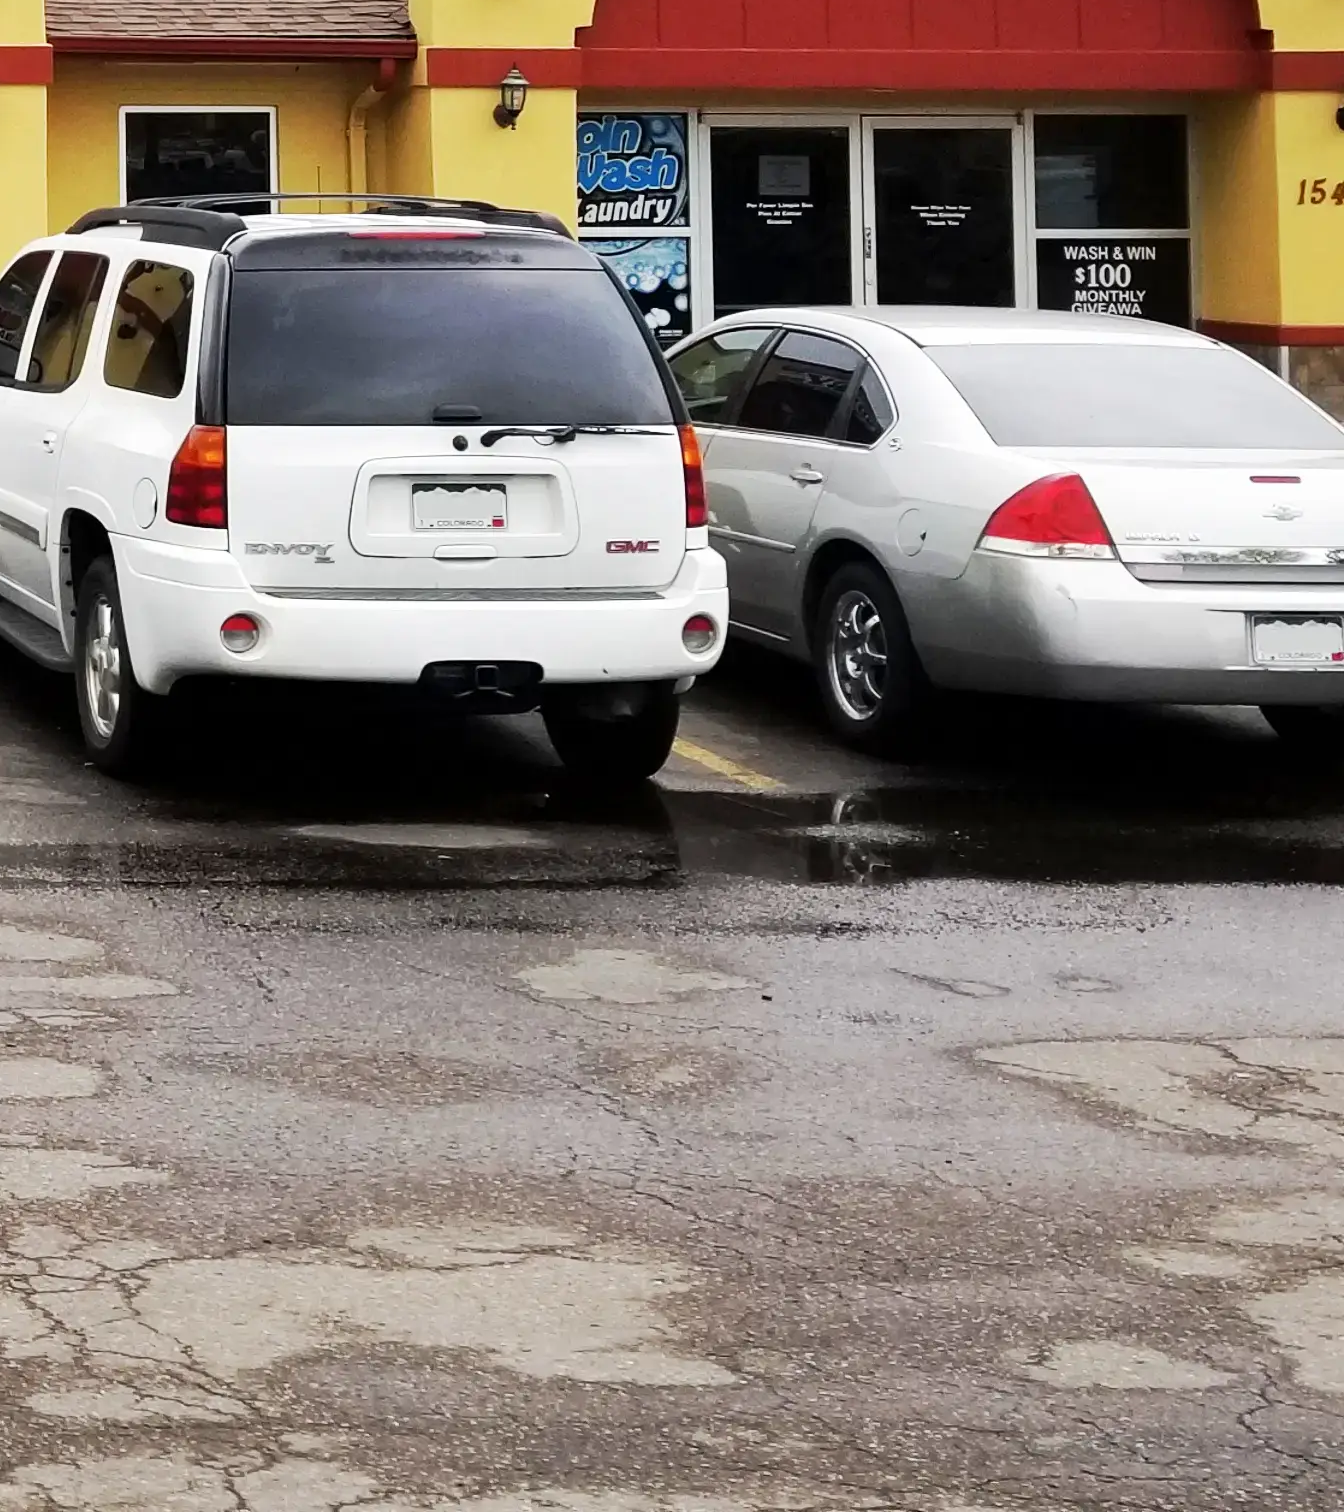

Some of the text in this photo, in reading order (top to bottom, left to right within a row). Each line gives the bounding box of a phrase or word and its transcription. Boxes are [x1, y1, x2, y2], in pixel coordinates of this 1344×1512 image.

[577, 114, 642, 154] oin
[1064, 246, 1156, 260] WASH & WIN
[1075, 263, 1132, 288] $100
[1075, 290, 1146, 303] MONTHLY
[1072, 302, 1142, 315] GIVEAWA
[244, 542, 335, 556] ENVOY
[605, 539, 660, 554] GMC
